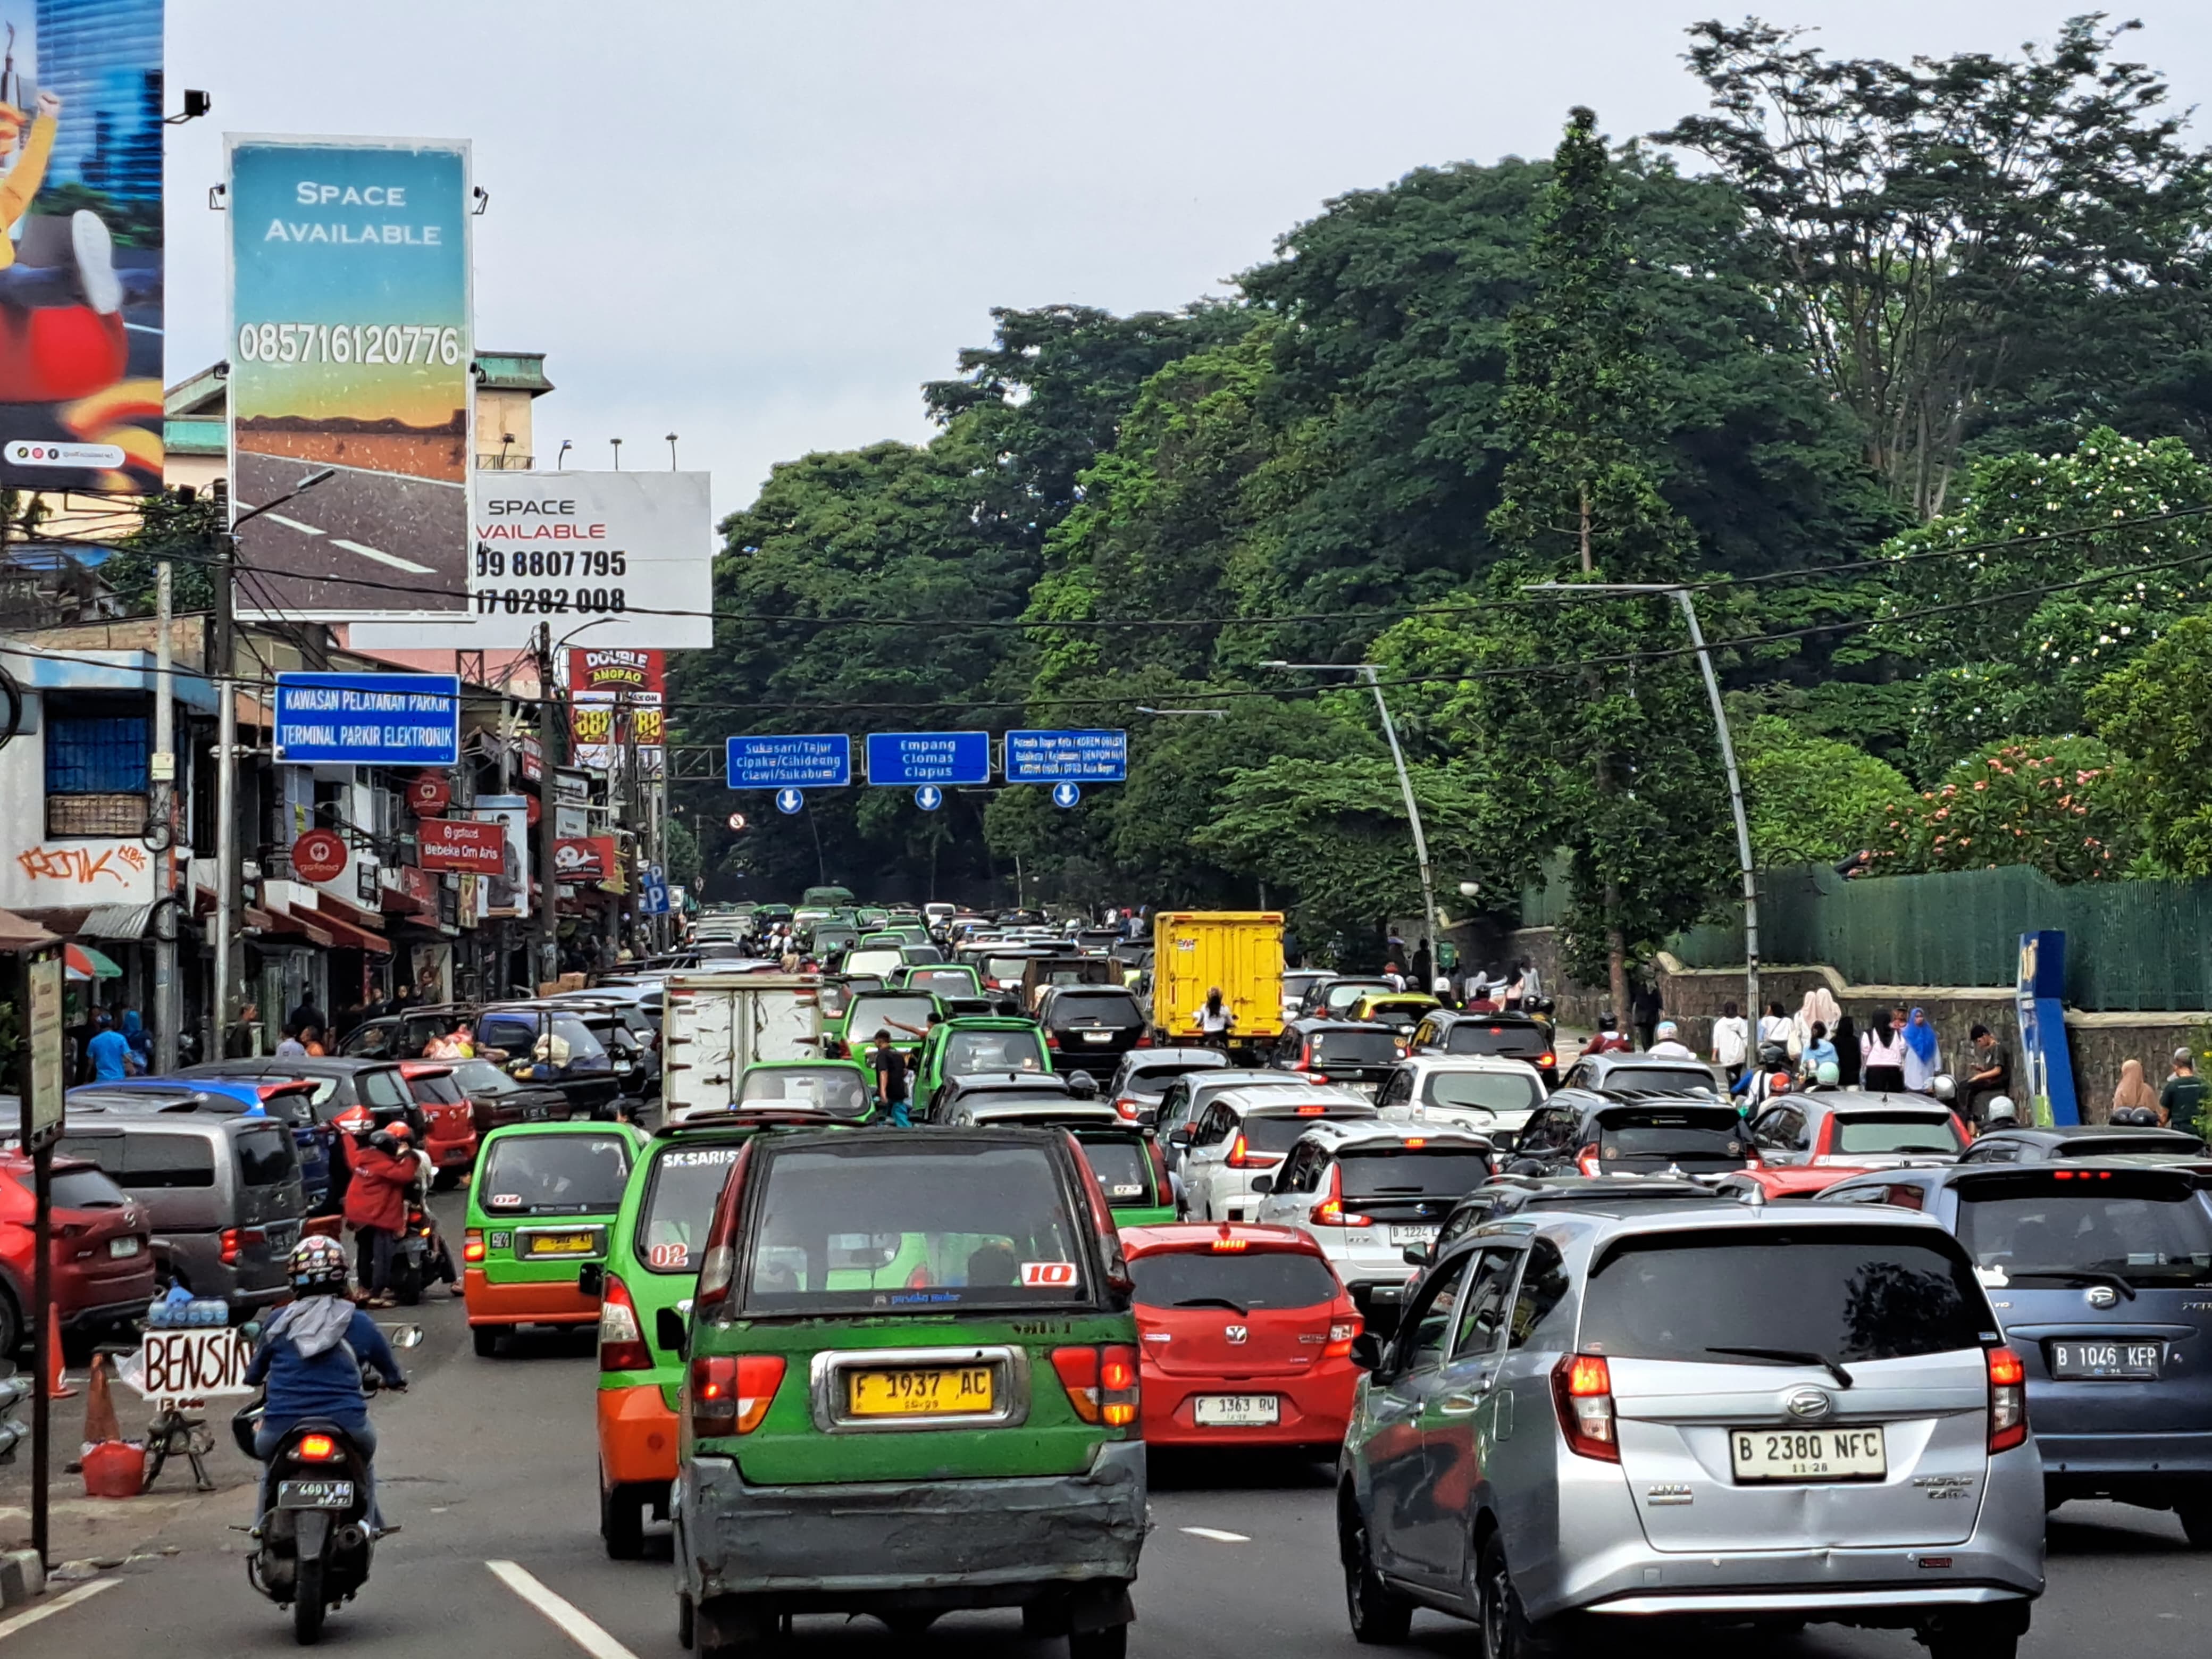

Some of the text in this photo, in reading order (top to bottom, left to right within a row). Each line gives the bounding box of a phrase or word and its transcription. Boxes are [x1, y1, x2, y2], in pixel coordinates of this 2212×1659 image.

[239, 323, 459, 366] 085716120776
[489, 500, 576, 515] SPACE
[476, 524, 606, 540] VAILABLE
[476, 550, 626, 577] 99 8807 795
[476, 588, 626, 614] 17 0282 008
[586, 651, 648, 669] DOUBLE
[285, 690, 450, 713] KAWASAN PELAYANAN PARKIR
[281, 724, 453, 747] TERMINAL PARKIR ELEKTRONIK
[900, 740, 956, 752] Empang
[649, 886, 664, 911] P
[651, 1244, 689, 1267] 02
[1028, 1264, 1073, 1283] 10
[2057, 1347, 2067, 1366] B
[2080, 1347, 2117, 1367] 1046
[856, 1371, 987, 1398] F 1937 AC
[1219, 1398, 1250, 1413] 1363
[1739, 1432, 1878, 1461] B 2380 NFC
